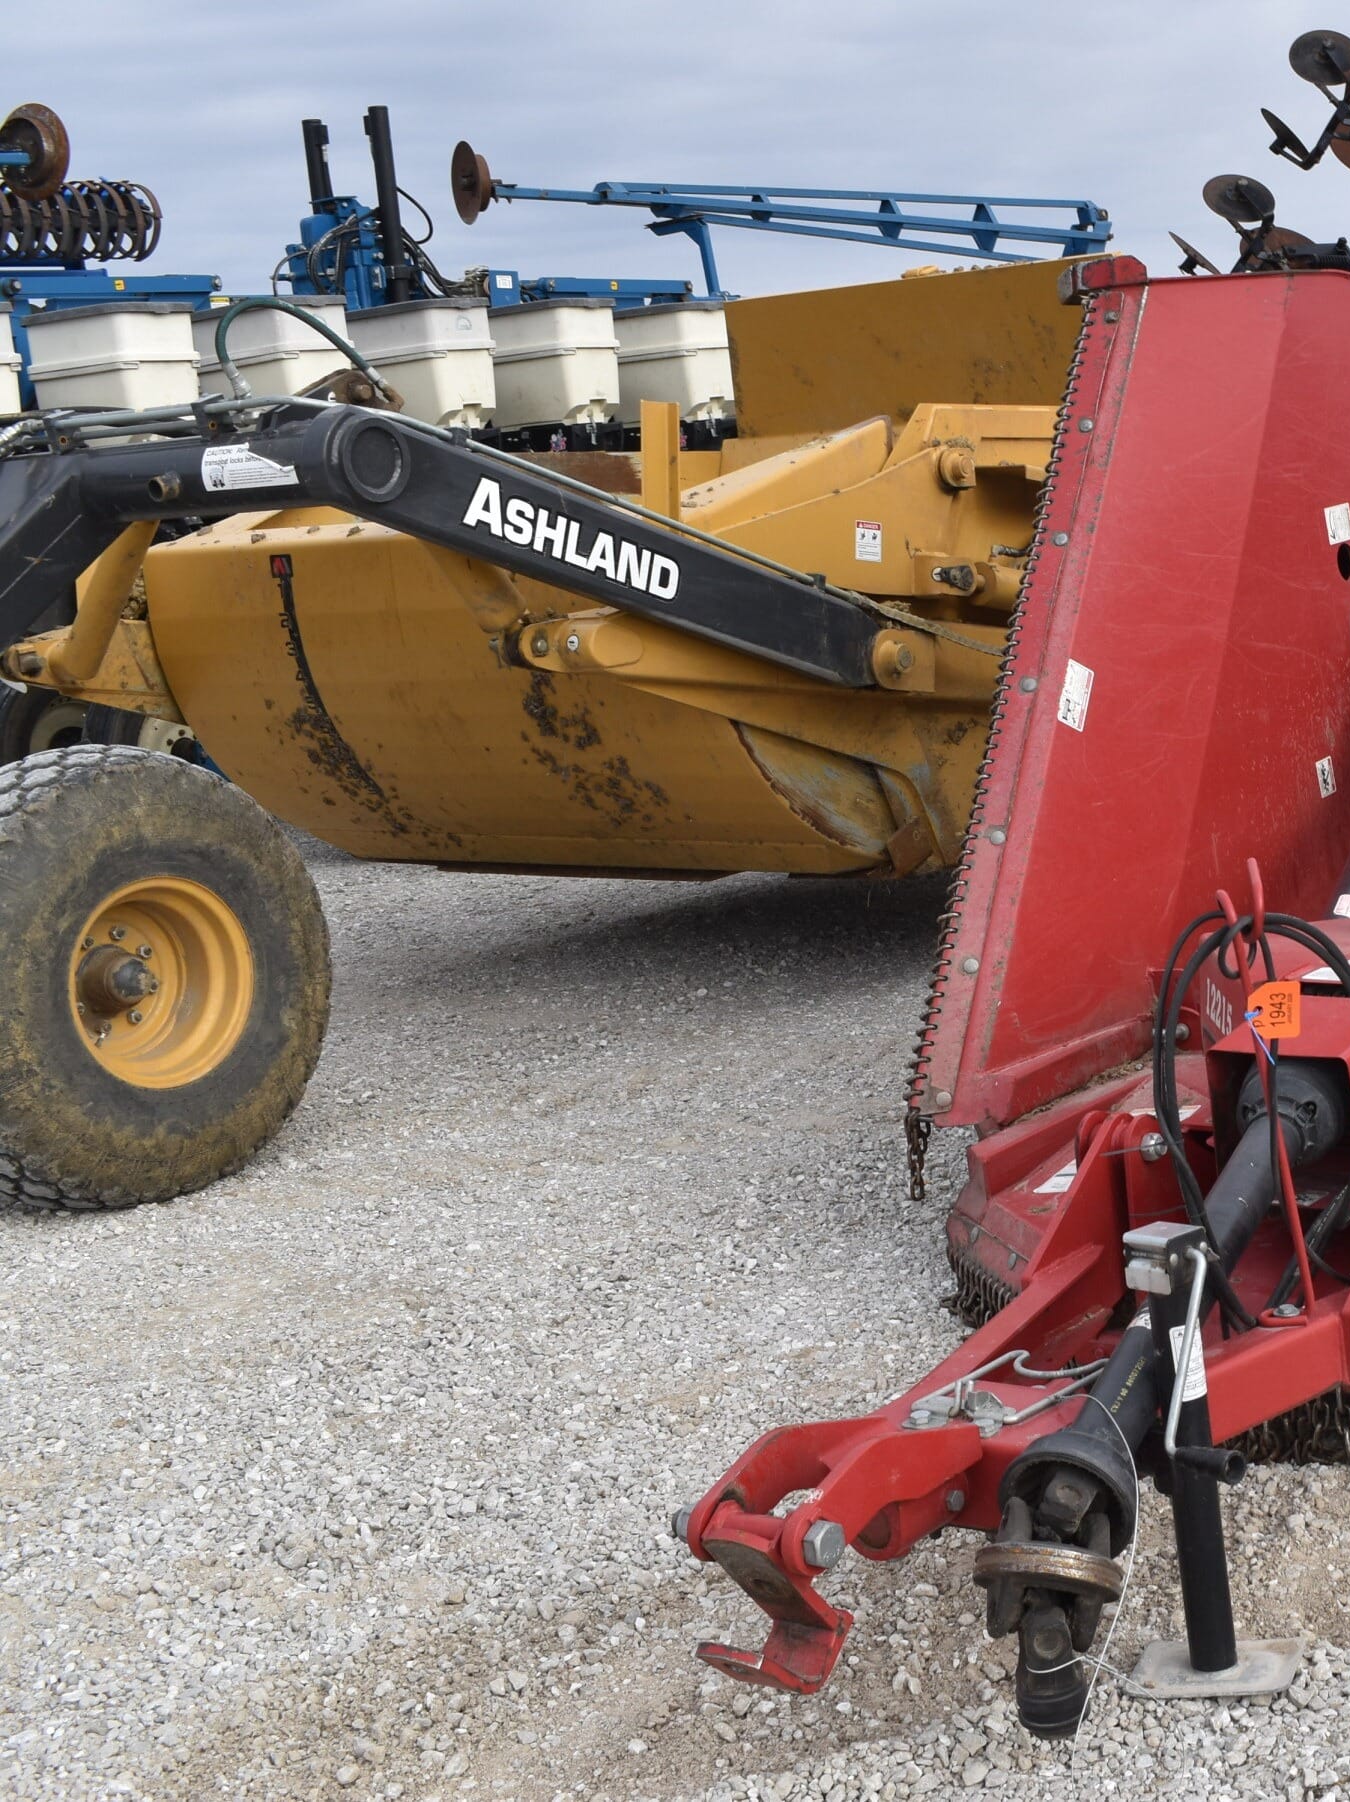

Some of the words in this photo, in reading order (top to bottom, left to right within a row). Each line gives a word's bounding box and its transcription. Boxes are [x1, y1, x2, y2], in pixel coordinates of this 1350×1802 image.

[462, 477, 680, 600] ASHLAND
[1206, 977, 1233, 1036] 12215
[1269, 992, 1287, 1028] 1943
